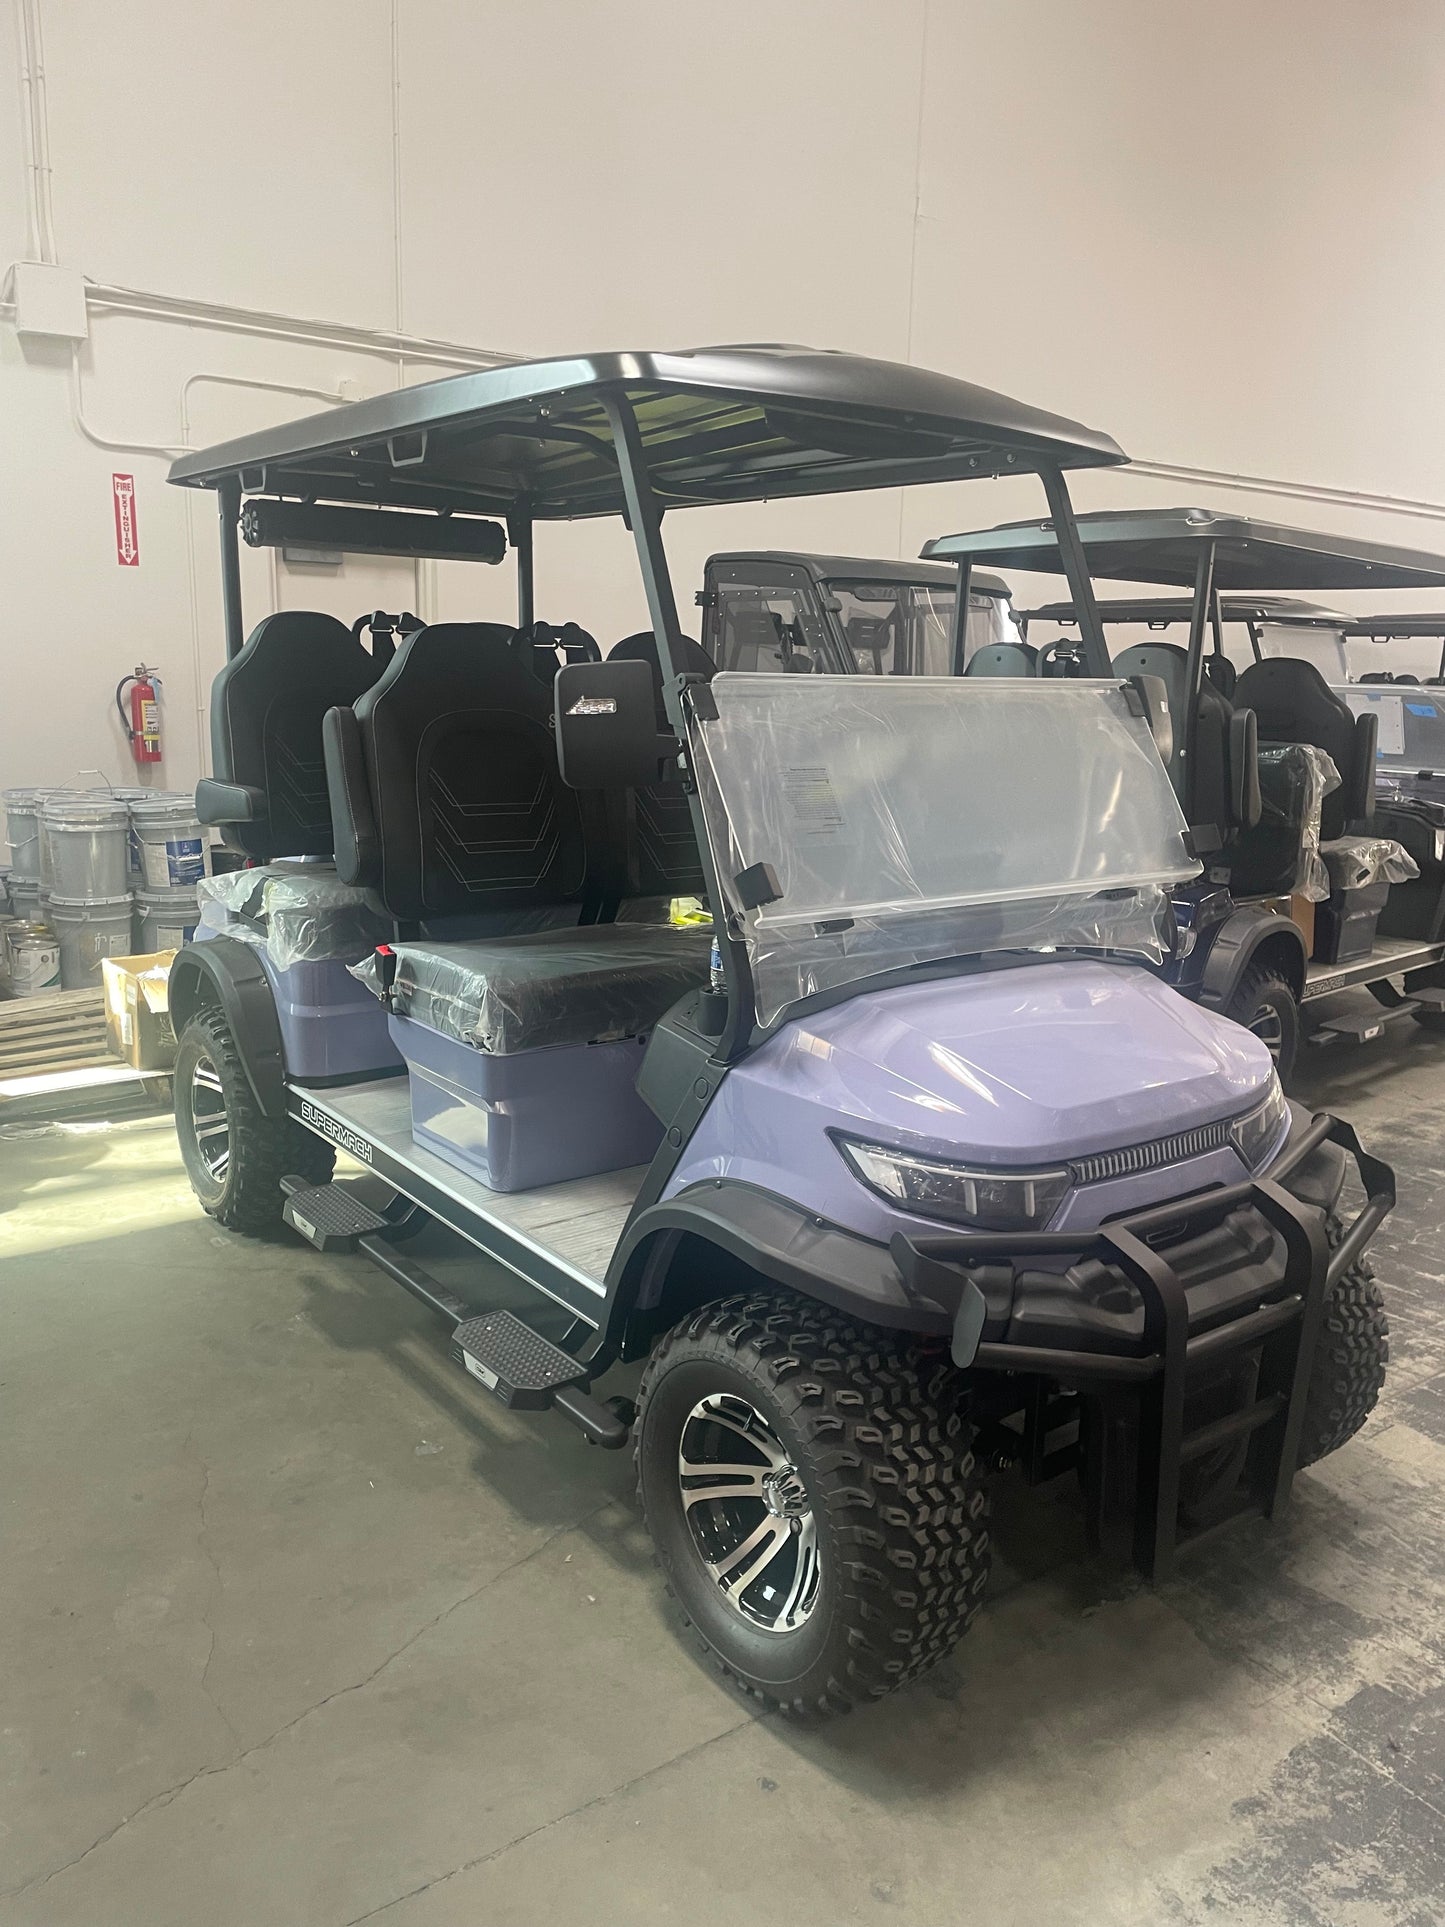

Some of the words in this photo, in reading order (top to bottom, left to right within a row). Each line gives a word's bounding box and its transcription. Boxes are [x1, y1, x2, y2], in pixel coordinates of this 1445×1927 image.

[116, 482, 131, 491] FIRE
[121, 494, 131, 559] EXTINGUISHER
[301, 1101, 373, 1163] SUPERMACH
